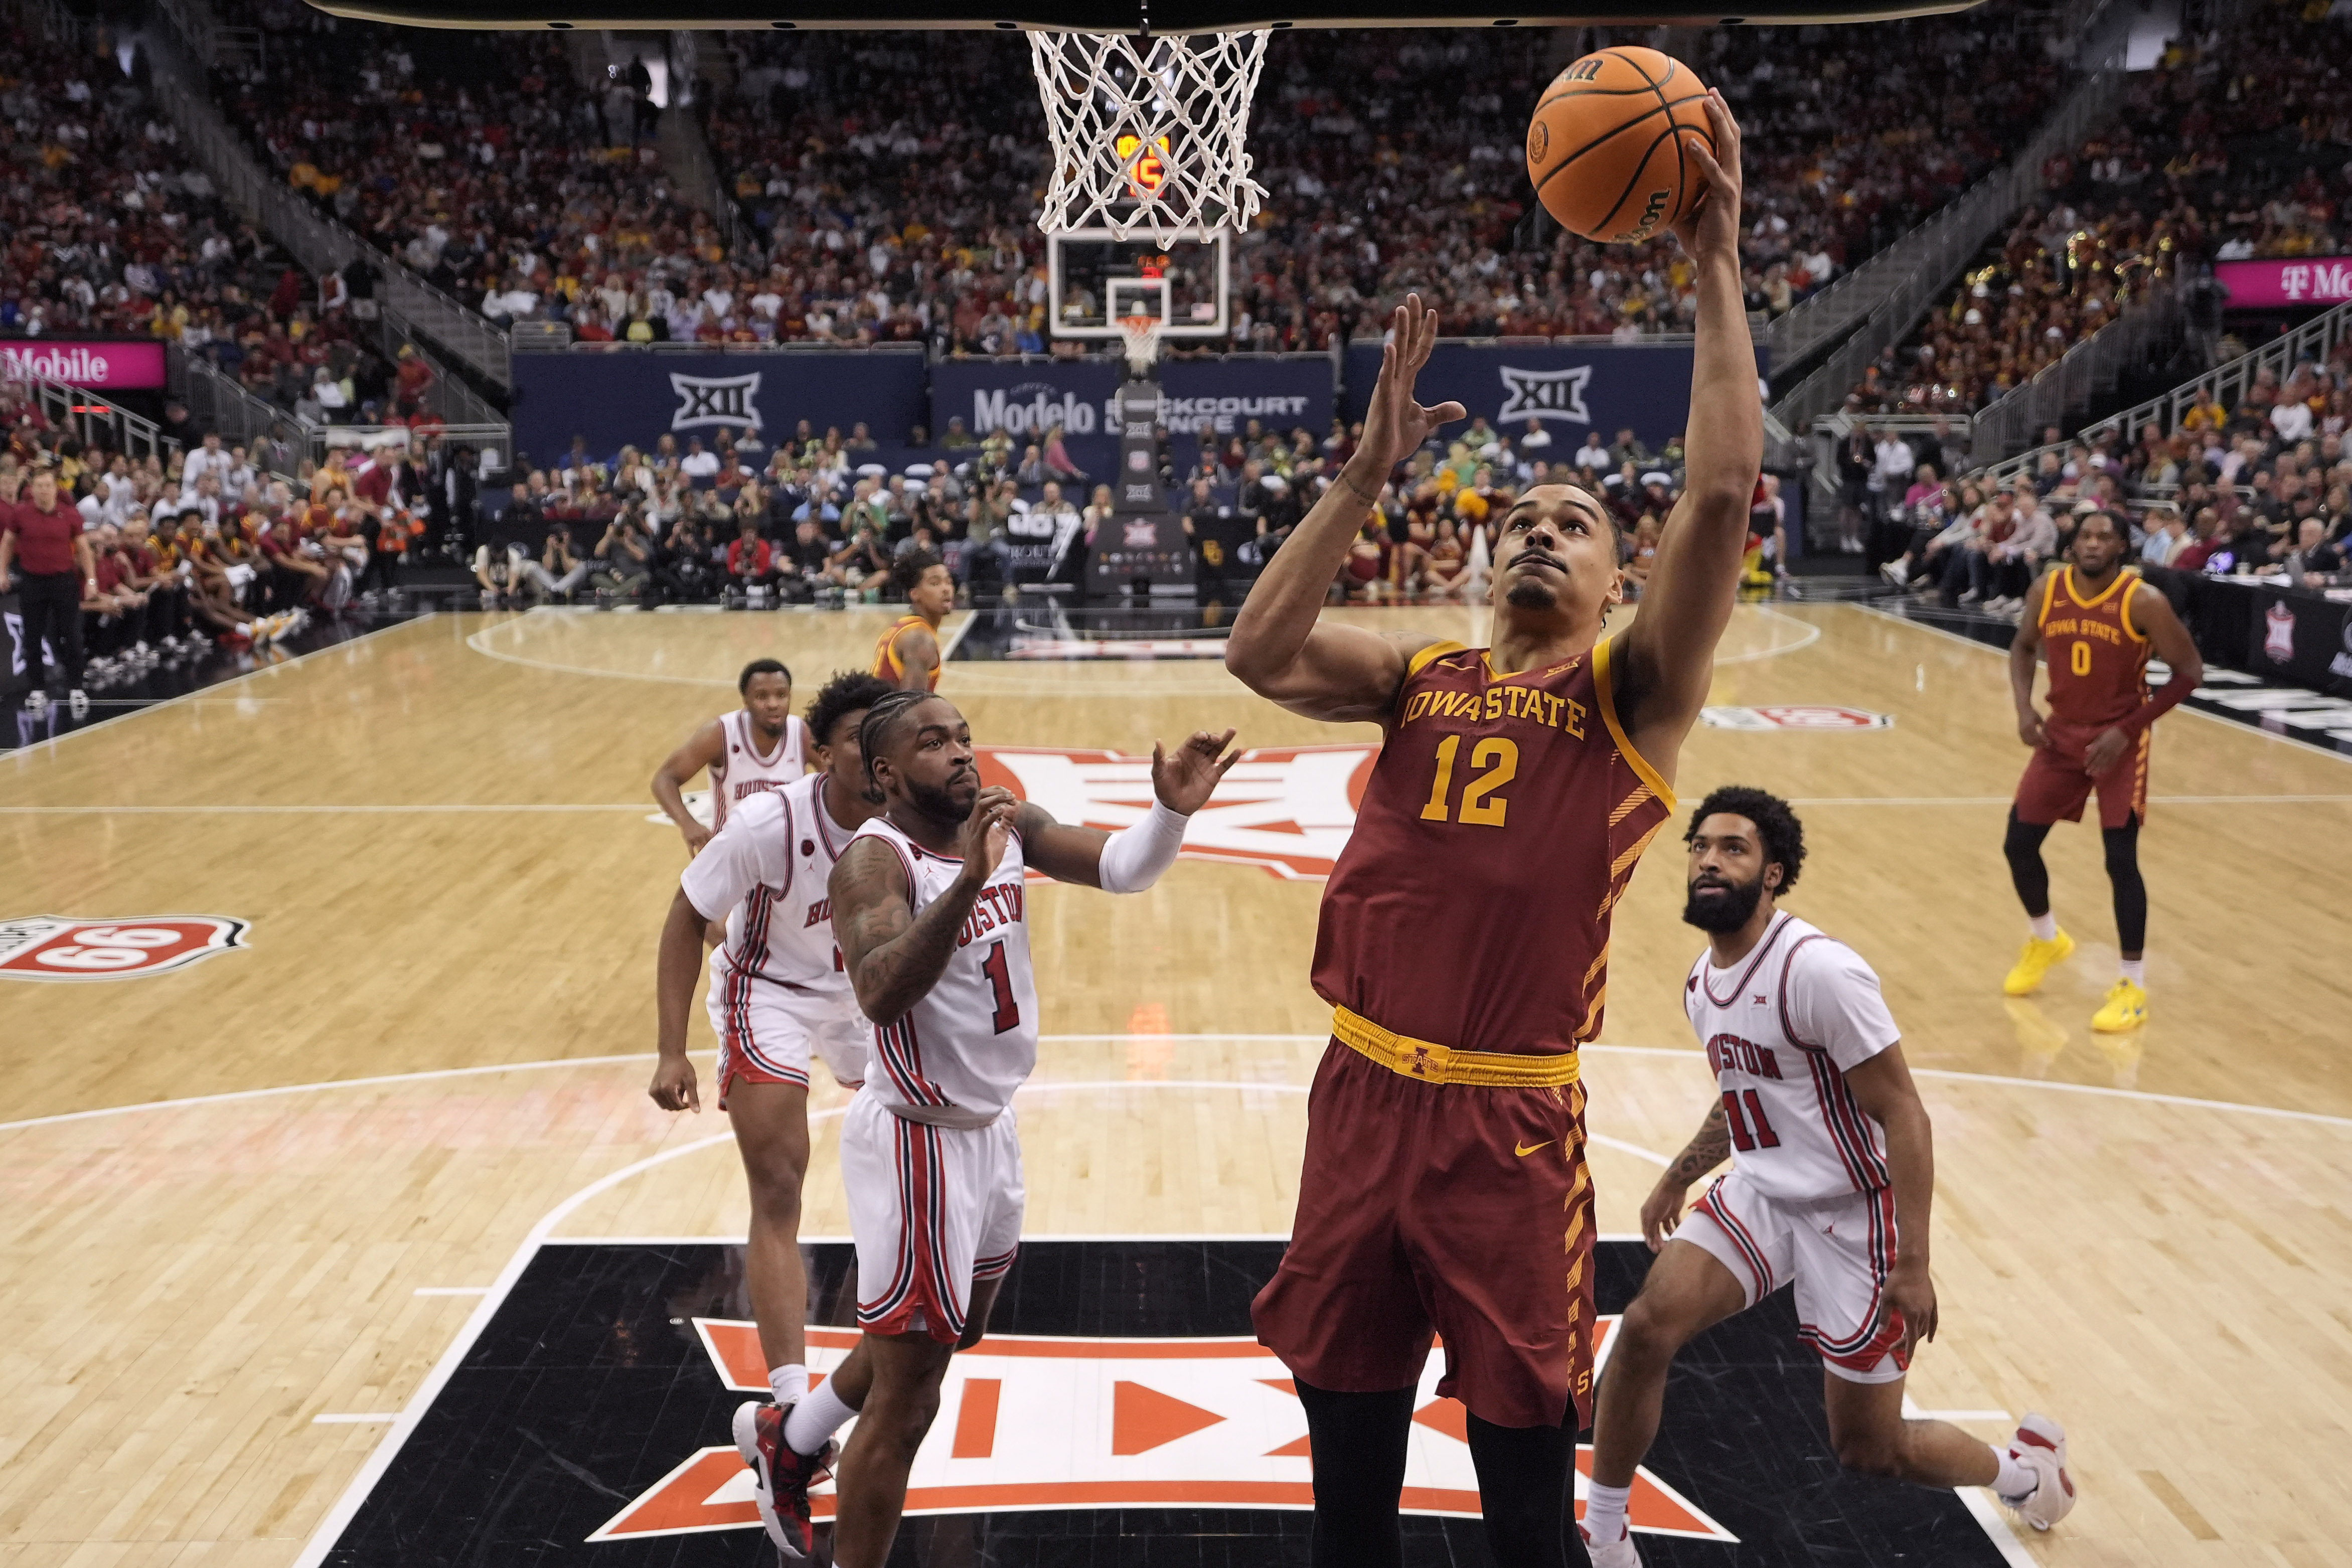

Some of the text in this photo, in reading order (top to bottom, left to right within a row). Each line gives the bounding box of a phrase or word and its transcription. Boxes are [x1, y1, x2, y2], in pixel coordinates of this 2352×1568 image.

[4, 348, 109, 382] Mobile
[677, 378, 755, 424] XII
[974, 388, 1096, 435] Modelo
[1506, 373, 1584, 417] XII
[1105, 415, 1235, 434] LNGE
[2080, 619, 2122, 646] STATE
[2071, 641, 2092, 677] 0
[1400, 685, 1587, 741] IOWA STATE
[1420, 734, 1519, 828] 12
[953, 884, 1022, 952] OUSTON
[36, 927, 183, 969] 66
[982, 938, 1020, 1035] 1
[1401, 1053, 1439, 1072] STATE
[1722, 1089, 1781, 1152] 11
[1577, 1365, 1595, 1396] S
